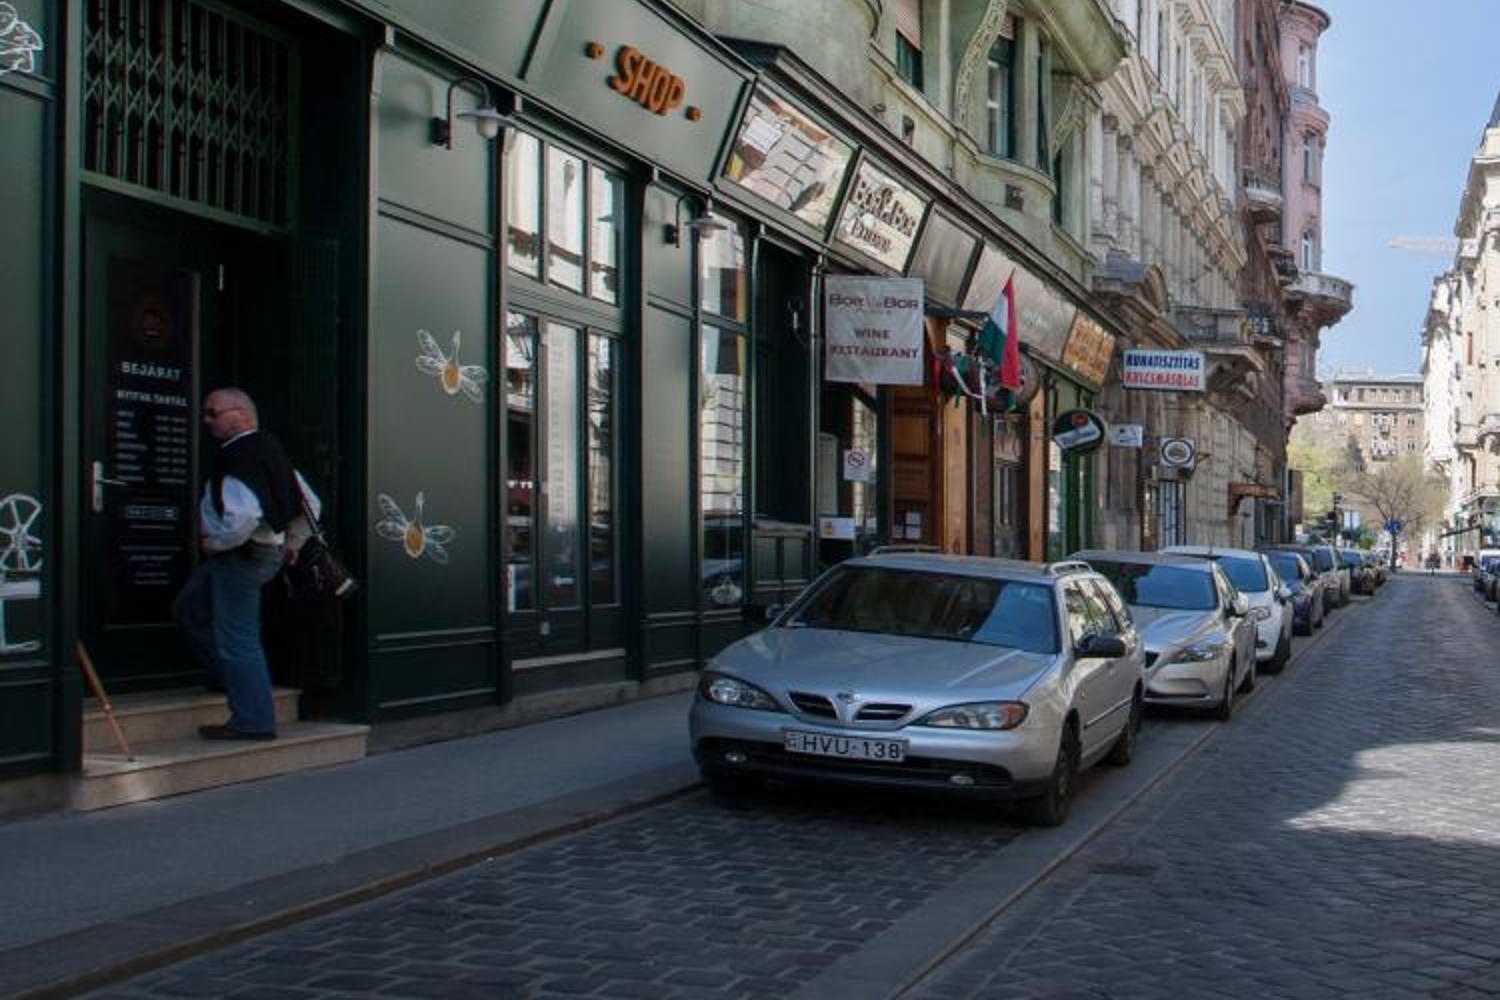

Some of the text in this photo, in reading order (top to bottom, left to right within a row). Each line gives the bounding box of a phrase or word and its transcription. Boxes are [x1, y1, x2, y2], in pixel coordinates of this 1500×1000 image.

[606, 44, 686, 116] SHOP
[854, 328, 891, 340] WINE
[829, 344, 919, 359] RESTAURANT
[121, 361, 180, 381] BEJÁRAT
